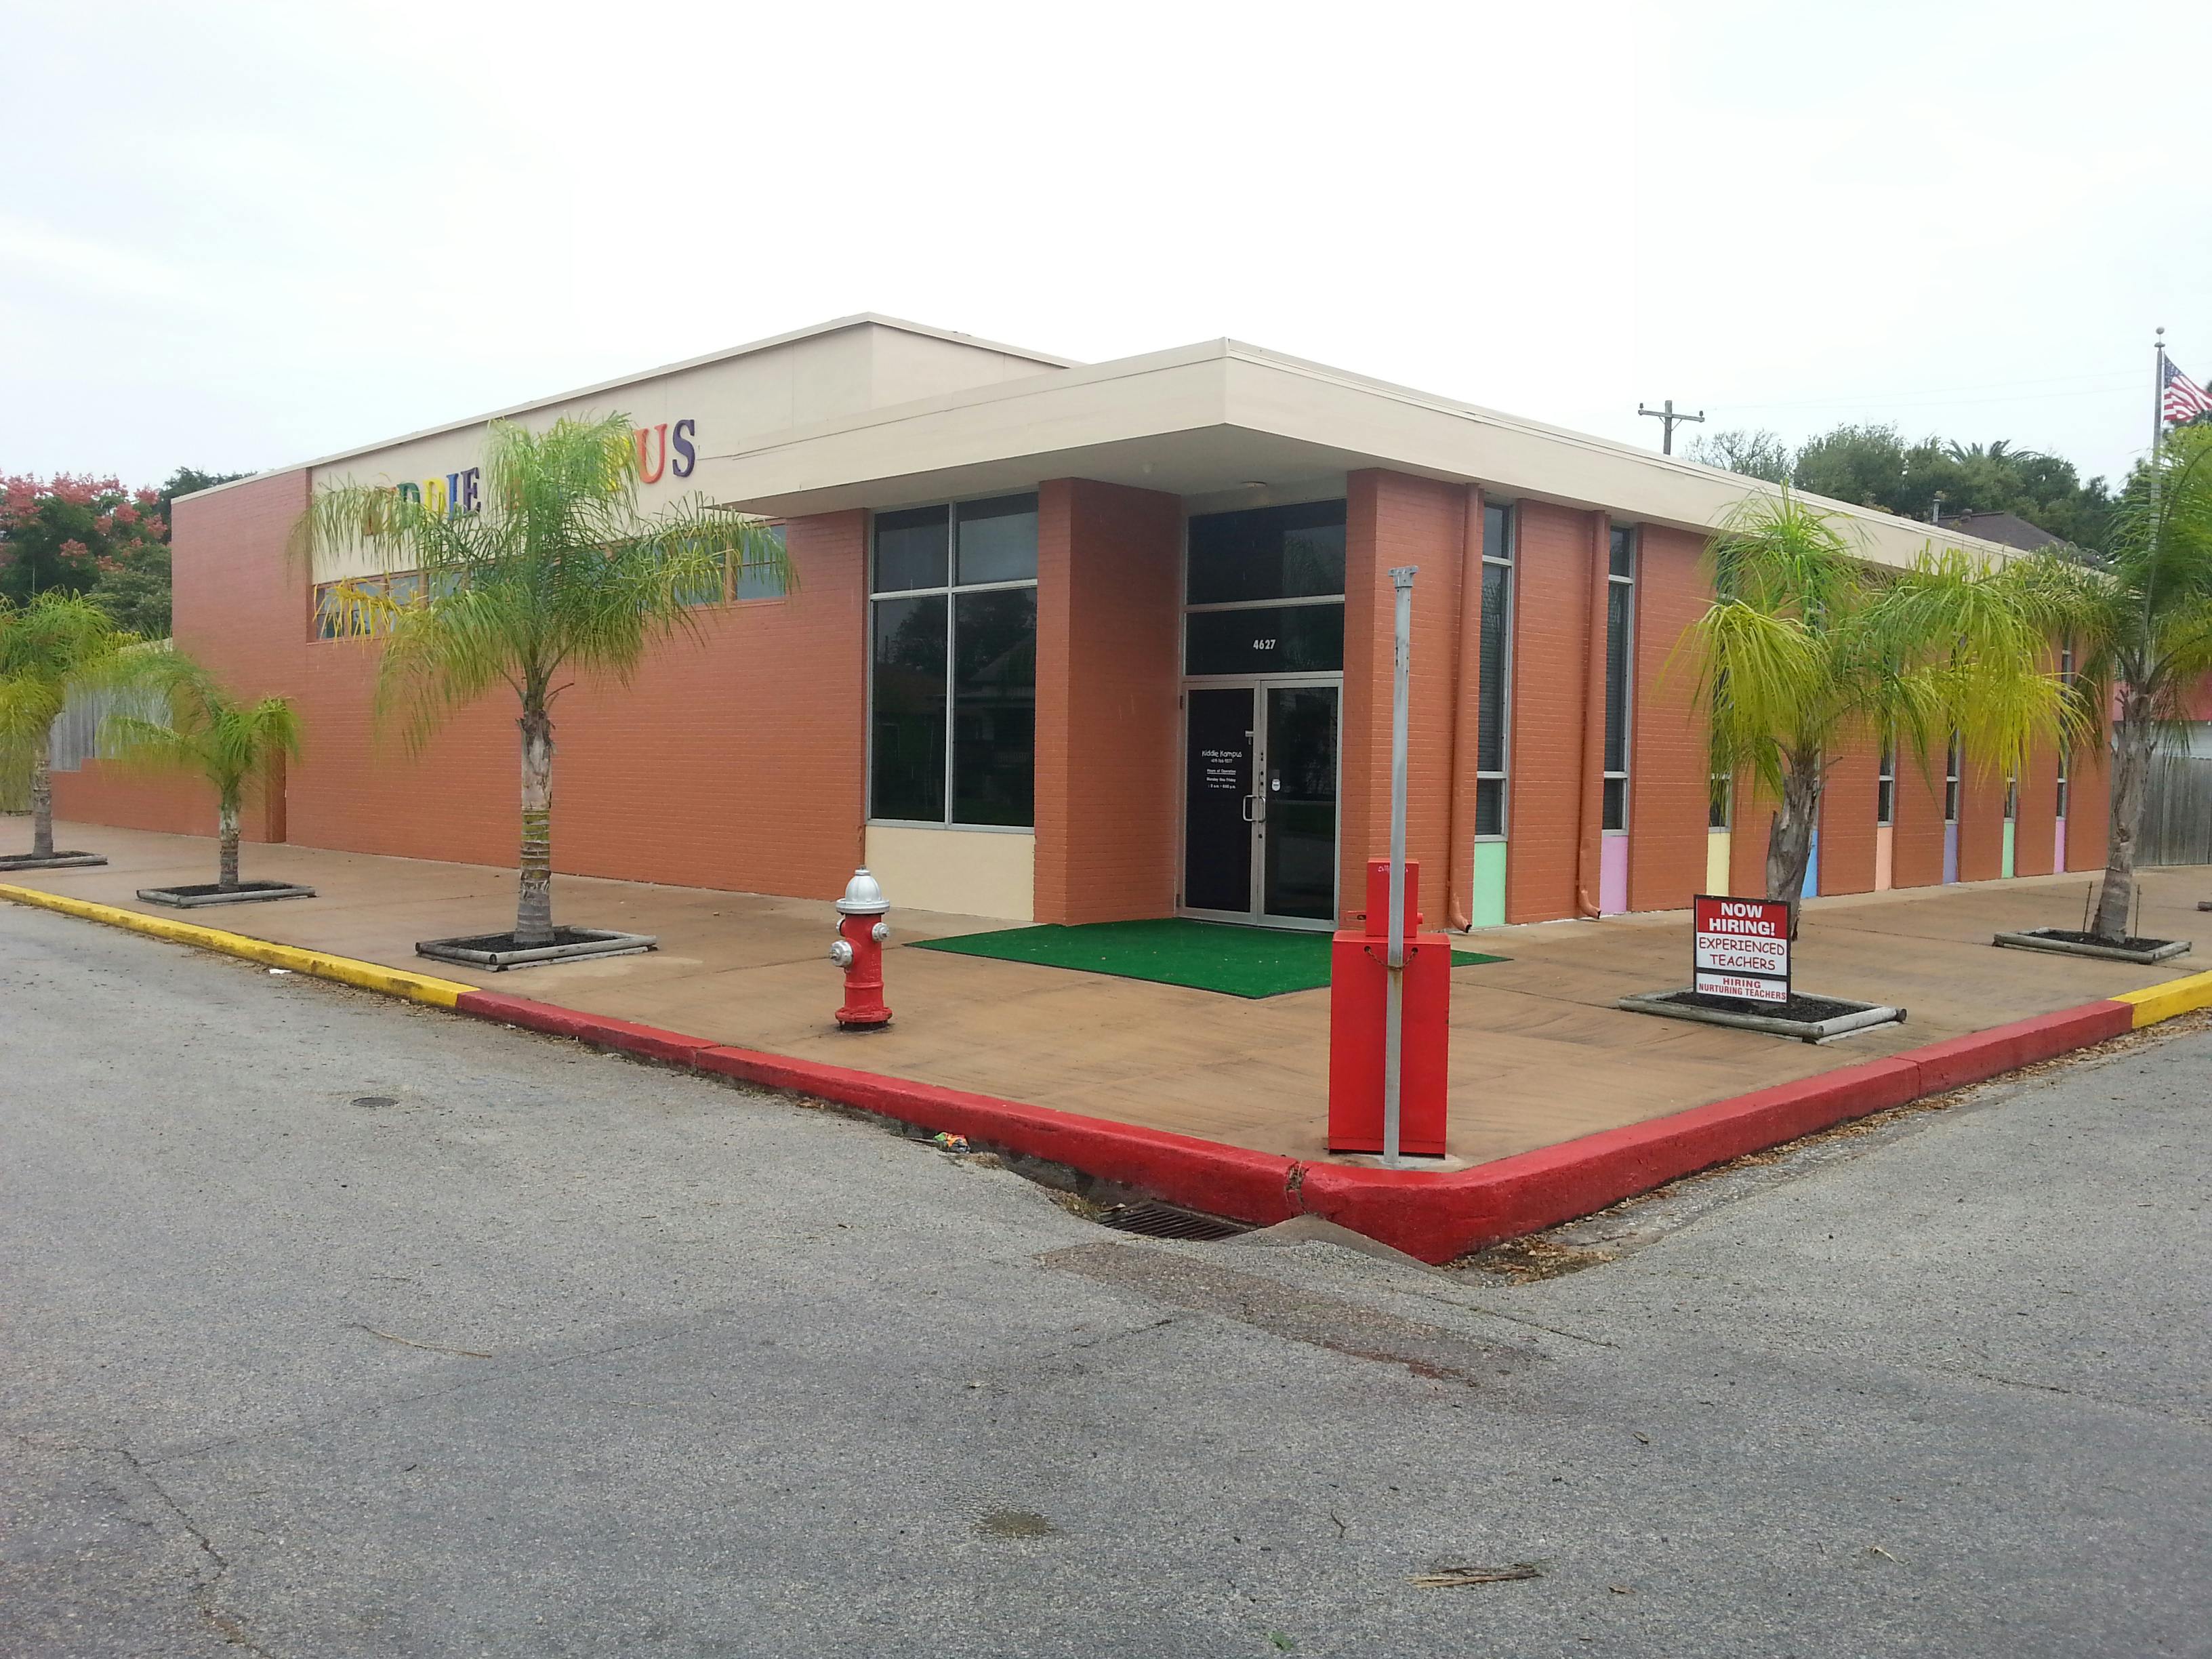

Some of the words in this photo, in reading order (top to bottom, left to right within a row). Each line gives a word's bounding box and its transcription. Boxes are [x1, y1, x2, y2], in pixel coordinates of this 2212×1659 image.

[1253, 639, 1276, 650] 4627
[1721, 902, 1763, 918] NOW
[1708, 918, 1775, 936] HIRING!
[1699, 937, 1785, 956] EXPERIENCED
[1709, 954, 1776, 970] TEACHERS
[1698, 983, 1743, 996] NURTURING
[1745, 987, 1786, 1000] TEACHERS
[1723, 978, 1761, 989] HIRING
